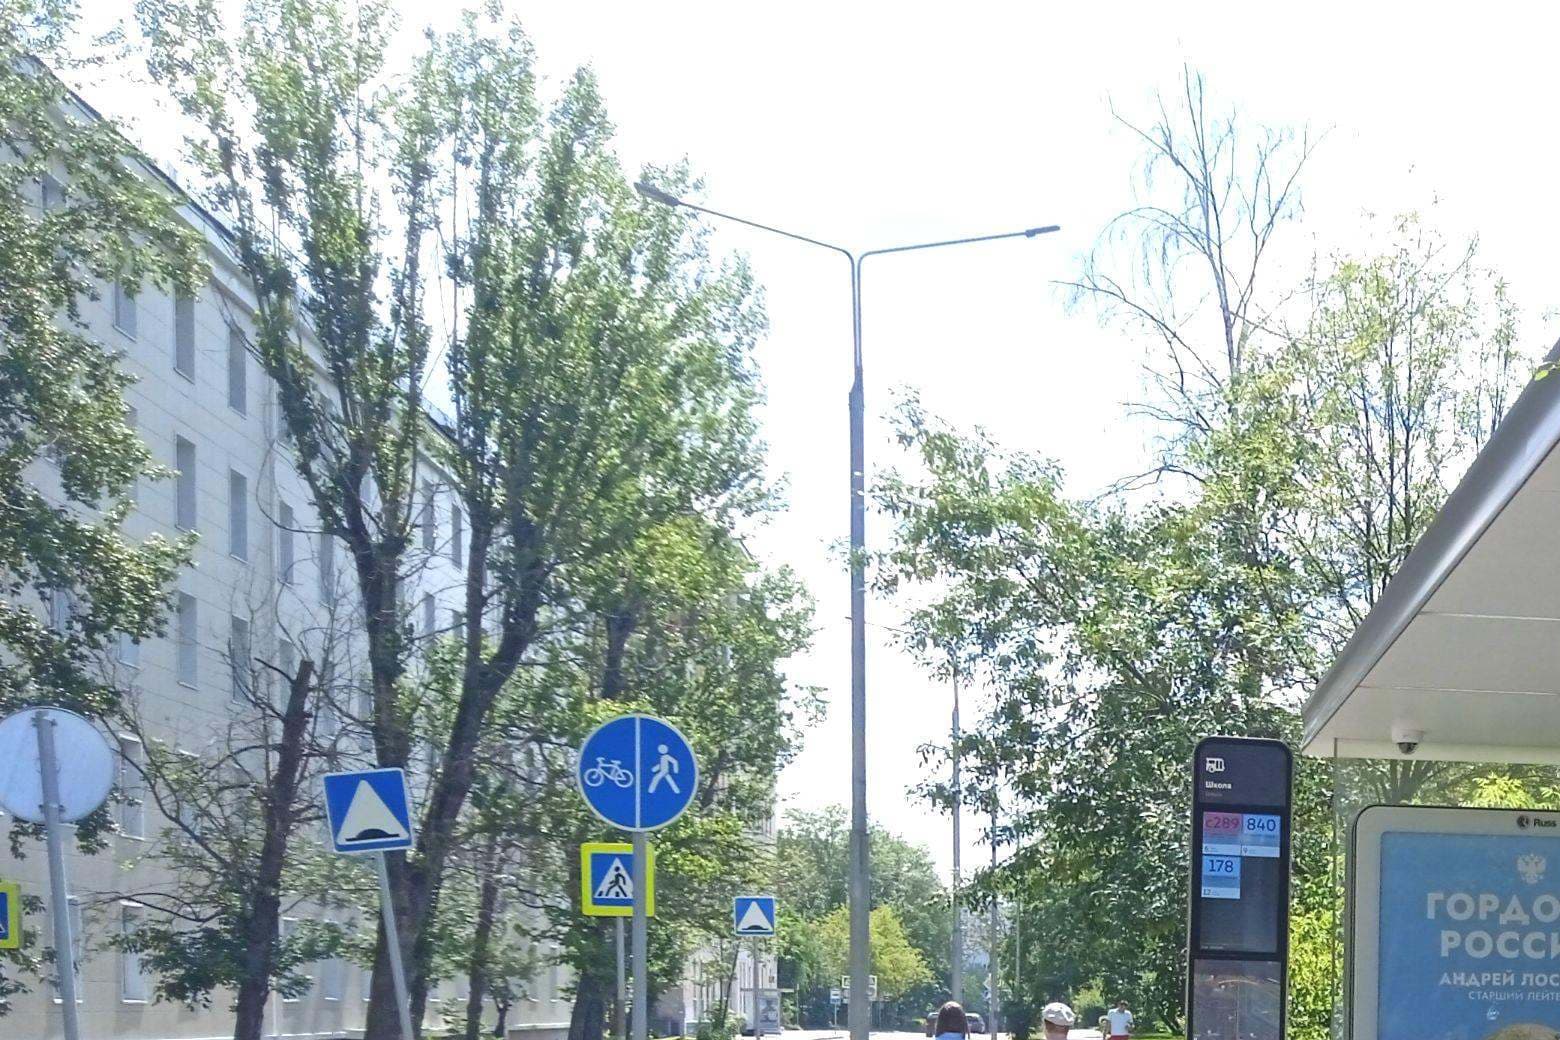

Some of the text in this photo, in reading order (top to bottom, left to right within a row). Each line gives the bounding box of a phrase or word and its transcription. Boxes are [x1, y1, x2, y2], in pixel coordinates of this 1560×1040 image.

[1205, 781, 1232, 789] Школа
[1246, 818, 1276, 832] 840
[1533, 818, 1557, 828] Russ
[1208, 859, 1234, 873] 178
[1439, 969, 1515, 988] АНДРЕЙ
[1468, 990, 1524, 1000] СТАРШИЙ
